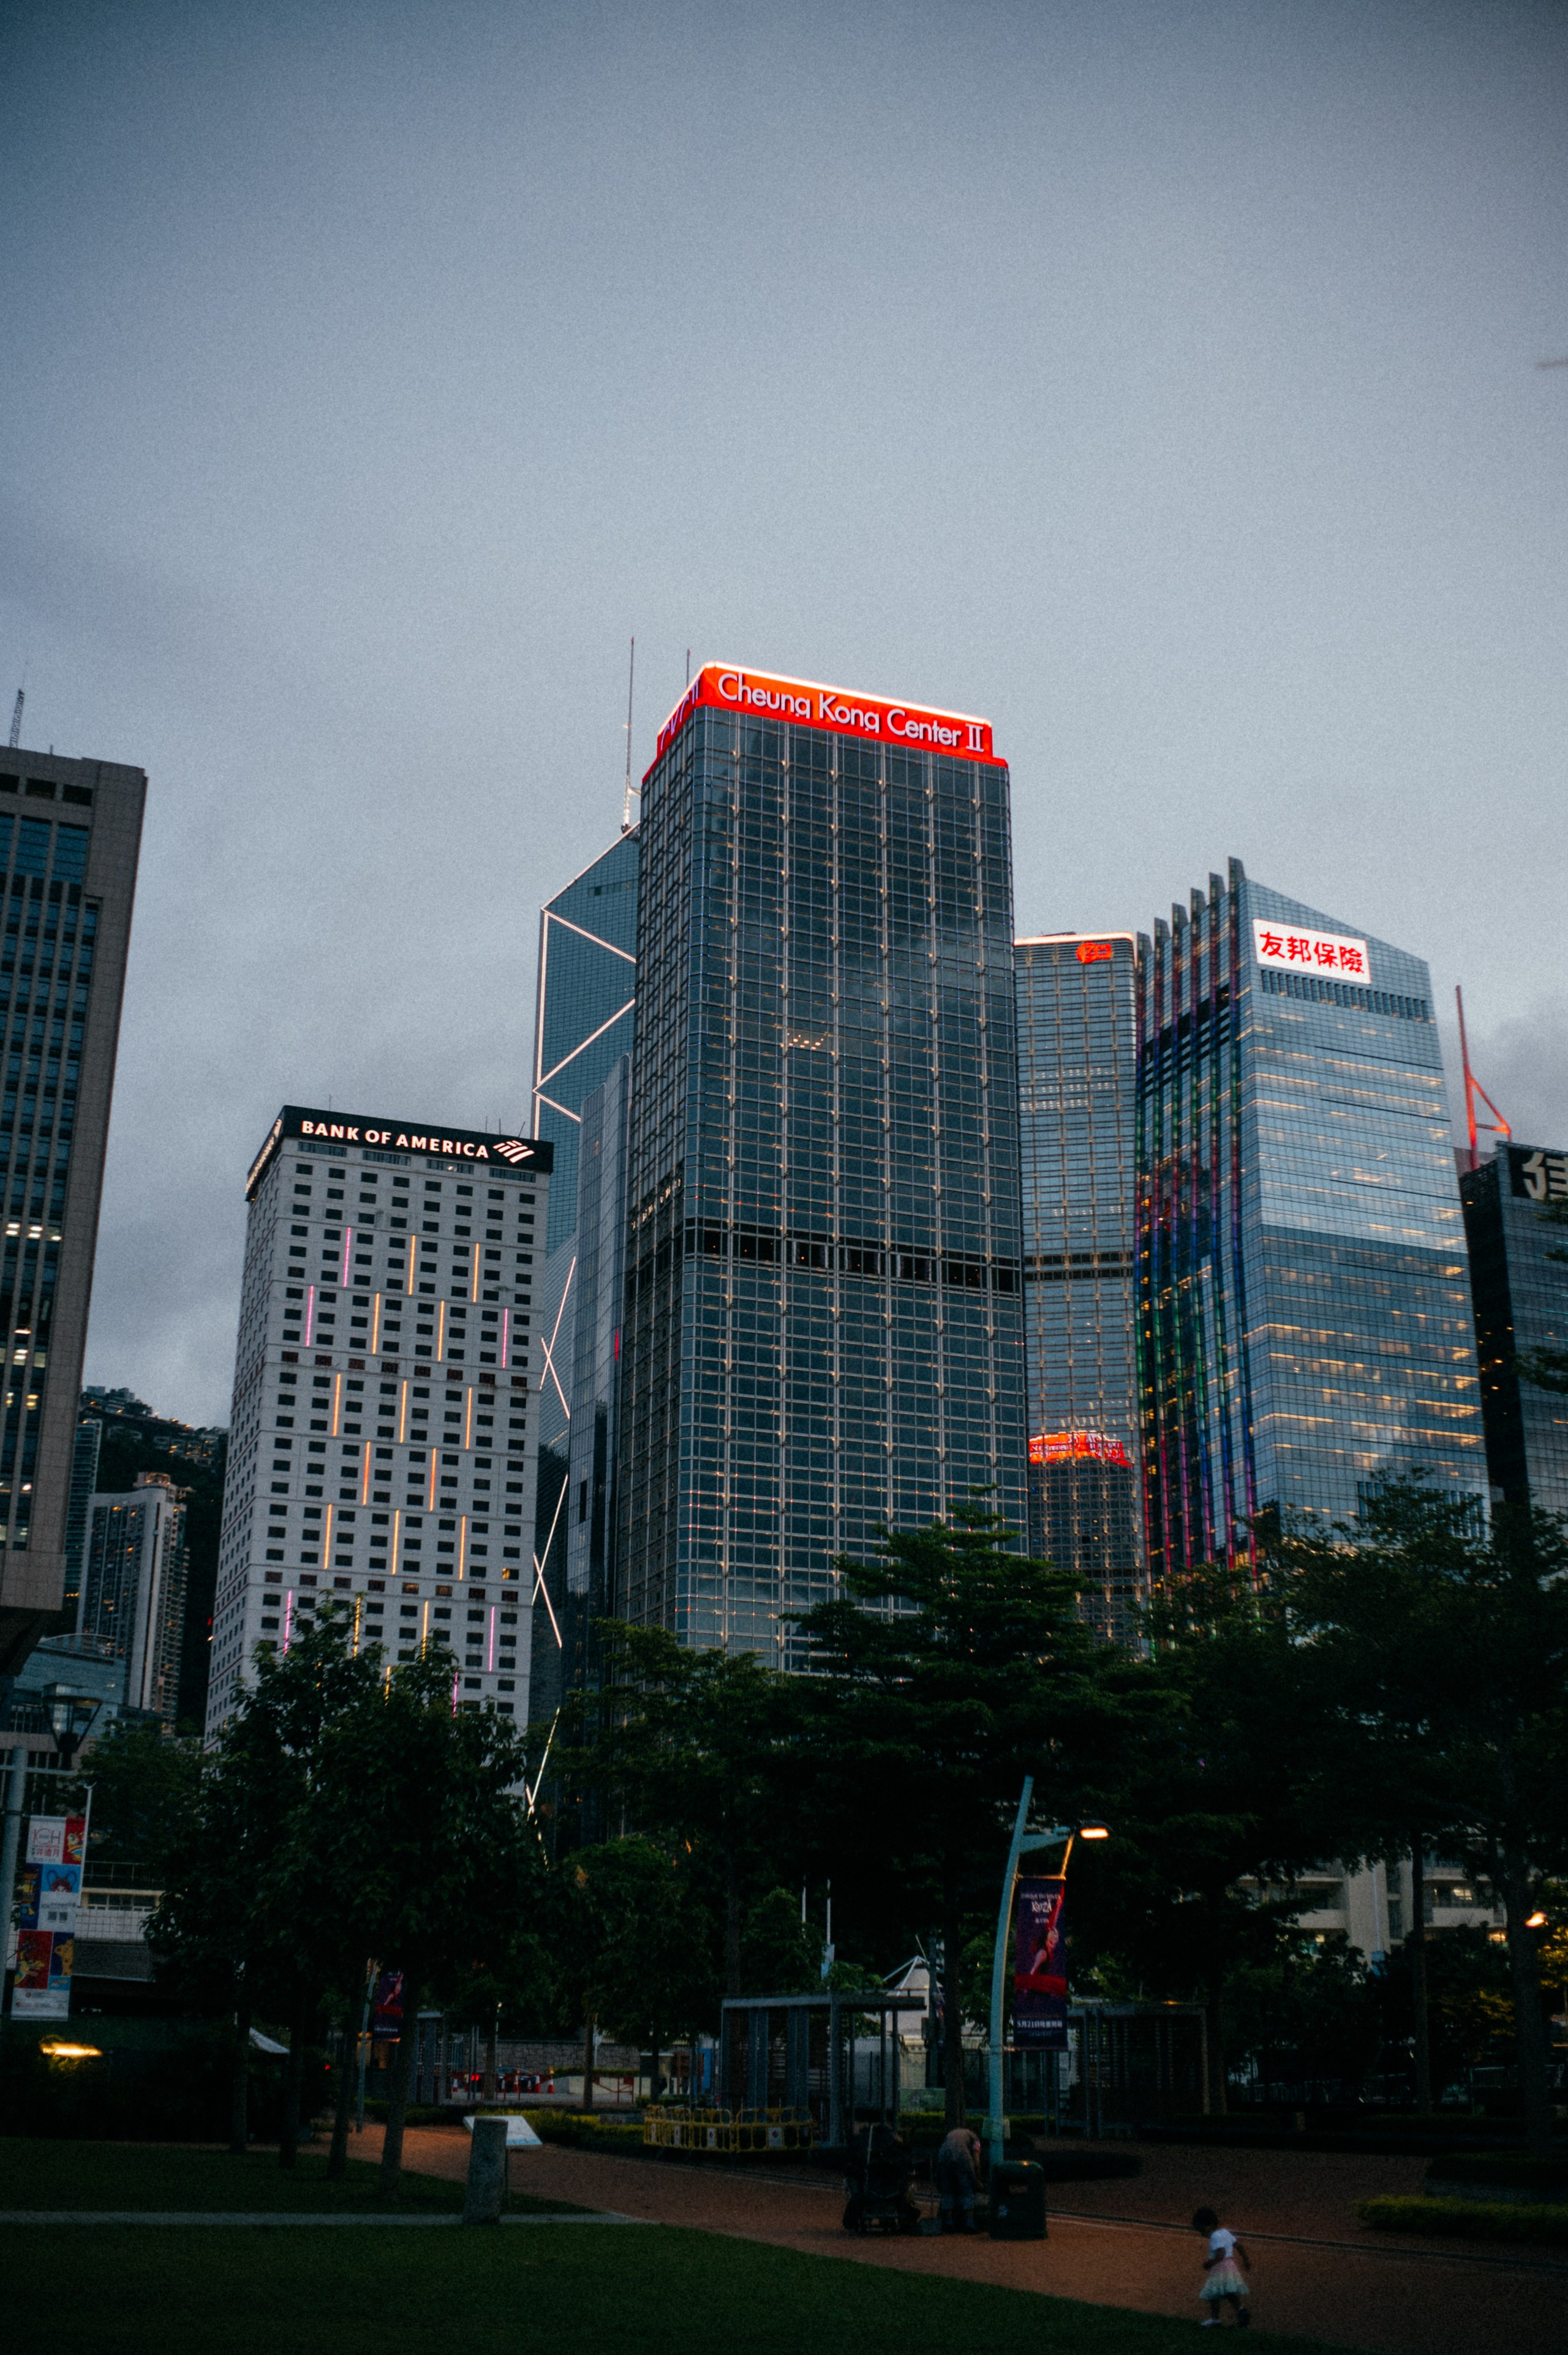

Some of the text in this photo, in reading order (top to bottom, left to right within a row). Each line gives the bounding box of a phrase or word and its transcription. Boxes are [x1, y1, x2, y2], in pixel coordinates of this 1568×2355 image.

[718, 672, 810, 719] Cheung
[819, 693, 880, 734] Kong
[887, 708, 962, 747] Center
[965, 724, 985, 753] II
[1259, 931, 1365, 973] 友邦保險
[301, 1120, 489, 1159] BANK OF AMERICA
